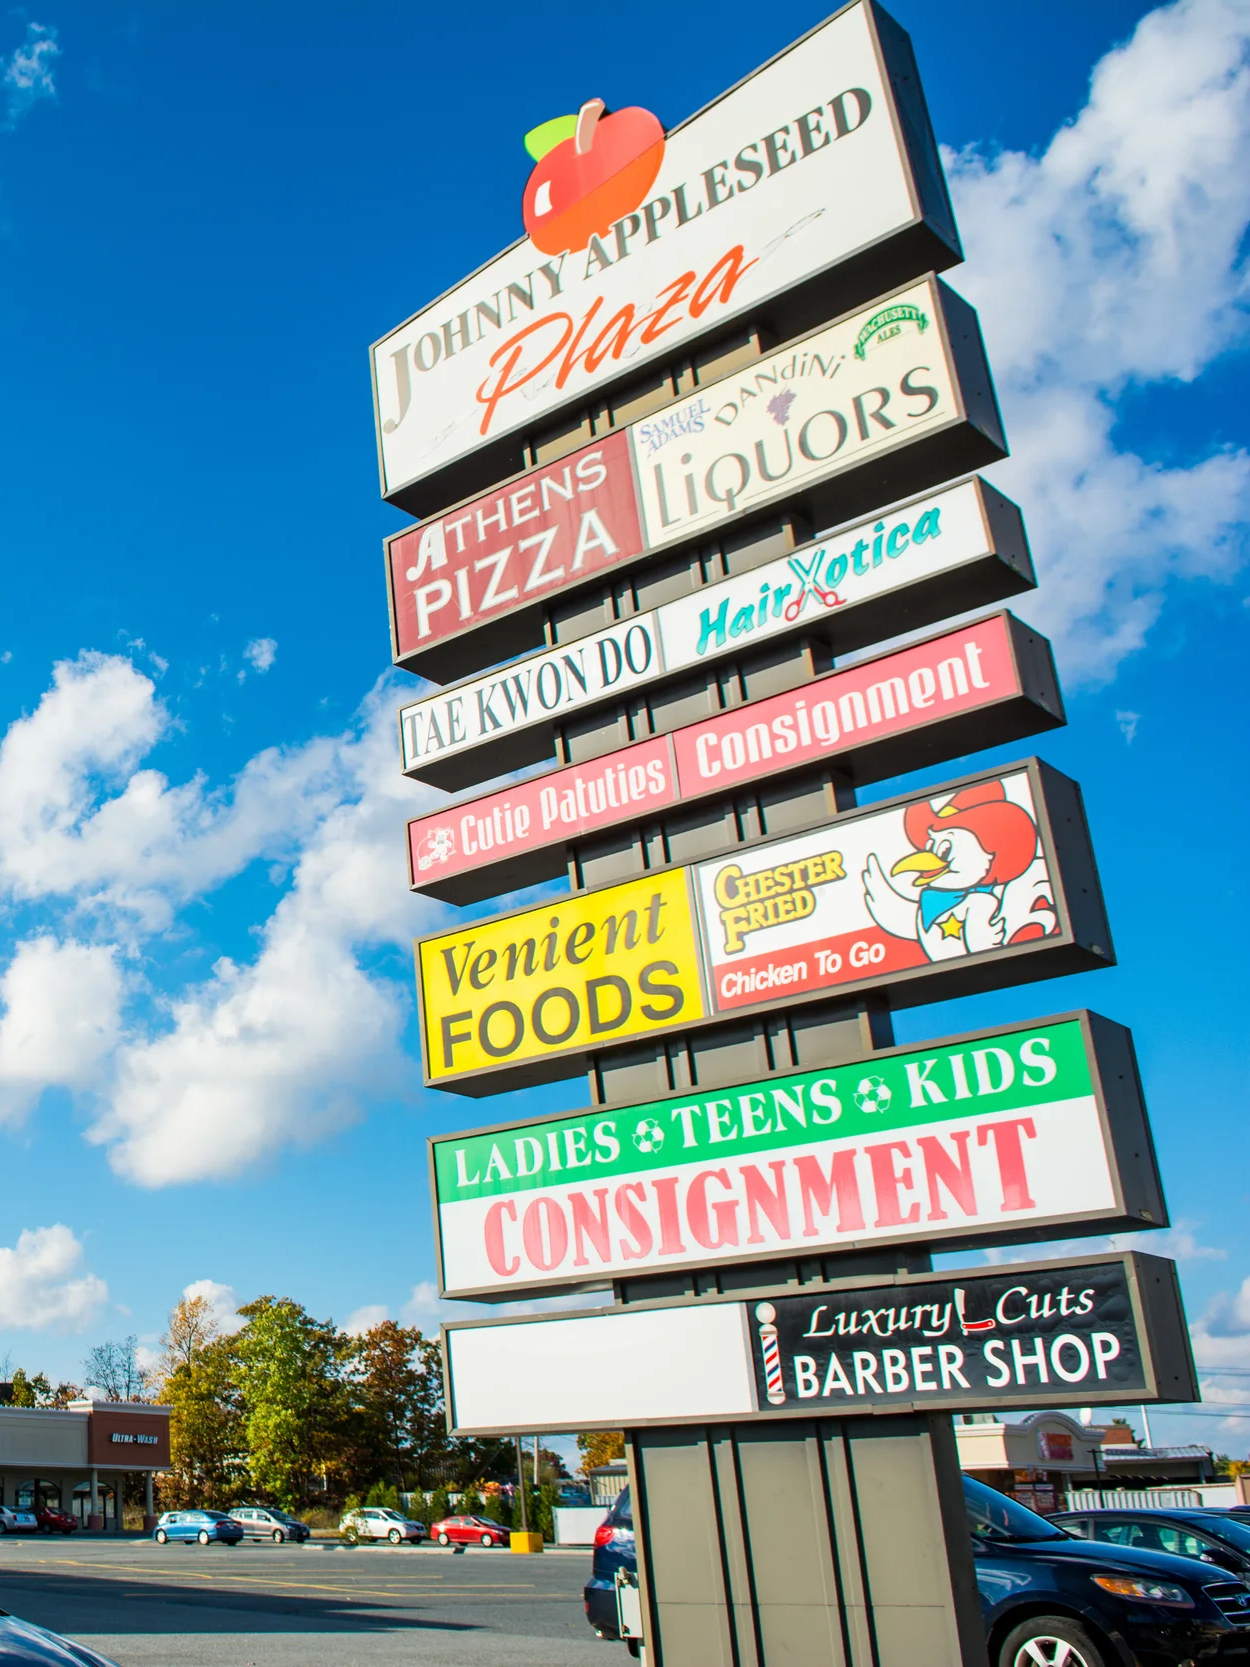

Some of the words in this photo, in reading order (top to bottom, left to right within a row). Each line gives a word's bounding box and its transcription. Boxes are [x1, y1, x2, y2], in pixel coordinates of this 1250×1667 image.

[383, 251, 569, 434] JOHNNY
[582, 86, 872, 281] APPLESEED
[475, 245, 760, 436] Plaza
[876, 324, 902, 345] ALES
[639, 398, 711, 444] SAMUEL
[647, 415, 705, 459] ADAMS
[406, 450, 607, 581] ATHENS
[414, 507, 620, 639] PIZZA
[404, 696, 466, 759] TAE
[474, 648, 589, 736] KWON
[595, 625, 652, 688] DO
[695, 641, 991, 780] Consignment
[460, 803, 530, 856] Cutie
[539, 759, 666, 831] Patuties
[714, 850, 847, 909] CHESTER
[719, 889, 816, 955] FRIED
[440, 893, 667, 996] Venient
[721, 961, 807, 998] Chicken
[814, 950, 842, 976] To
[849, 941, 886, 968] Go
[441, 959, 684, 1068] FOODS
[454, 1121, 621, 1187] LADIES
[671, 1077, 842, 1149] TEENS
[906, 1037, 1058, 1108] KIDS
[484, 1117, 1037, 1276] CONSIGNMENT
[803, 1302, 953, 1338] Luxury
[995, 1286, 1096, 1325] Cuts
[794, 1344, 971, 1398] BARBER
[983, 1332, 1121, 1389] SHOP
